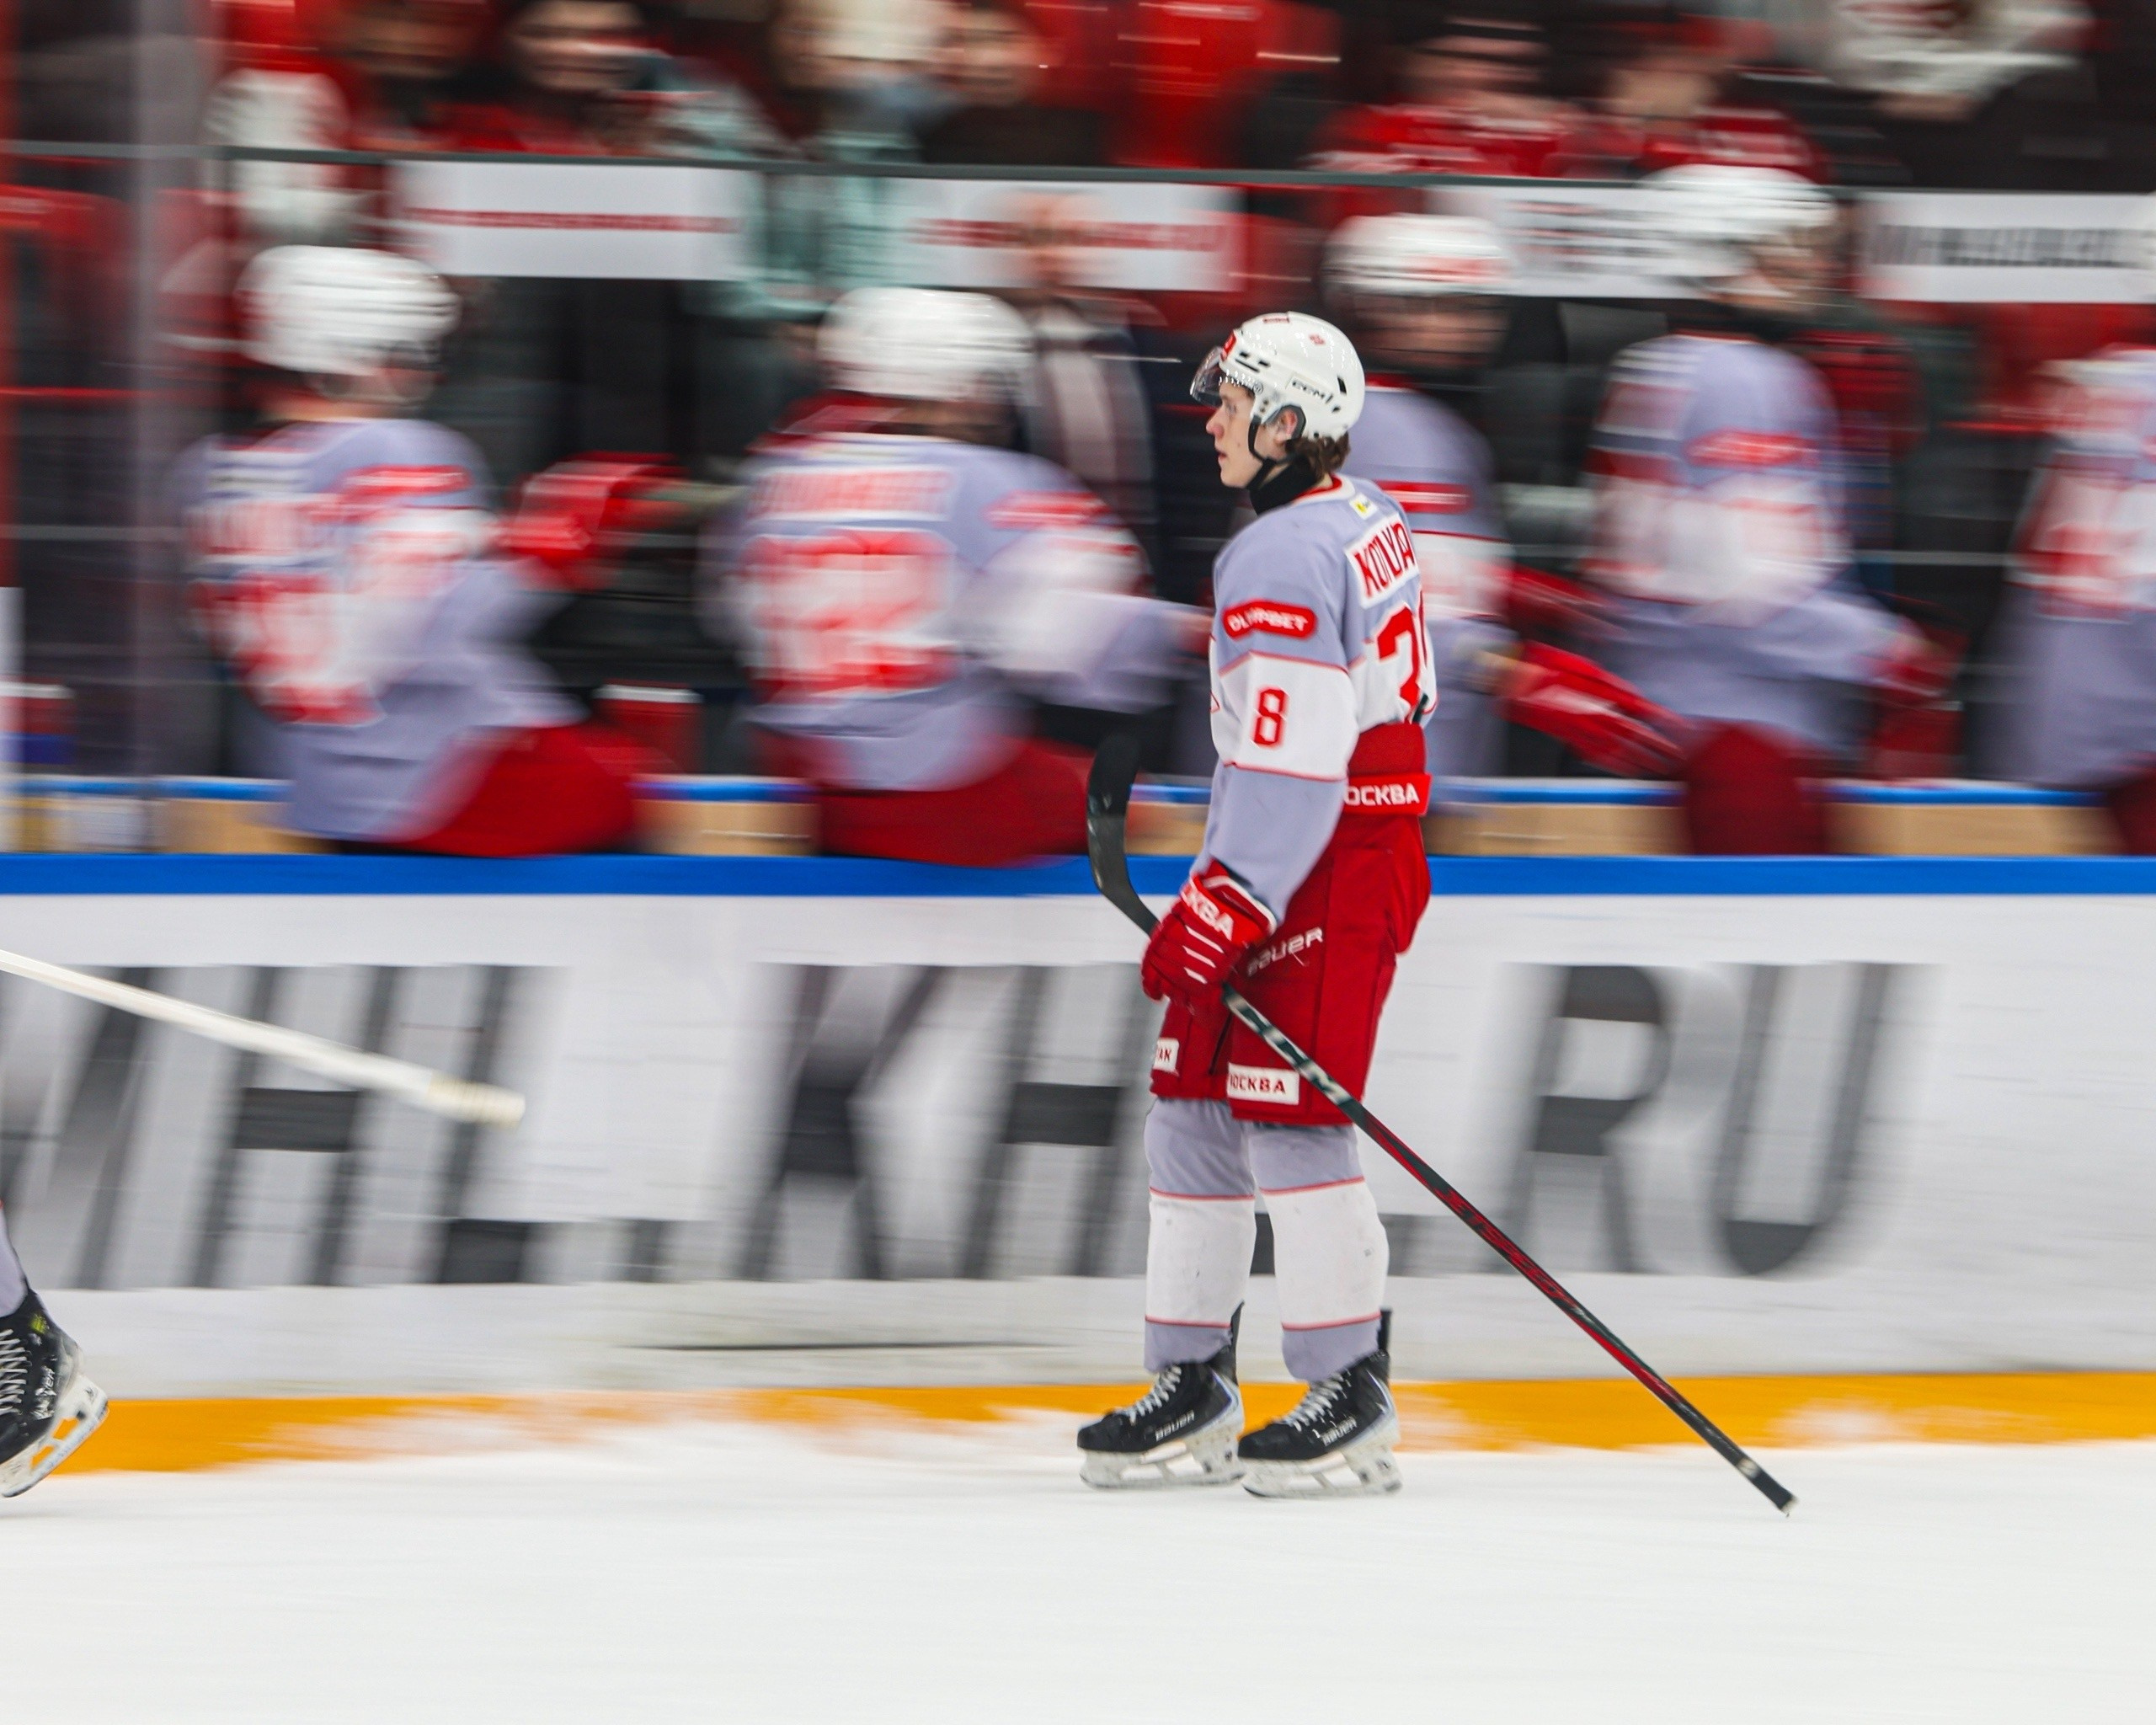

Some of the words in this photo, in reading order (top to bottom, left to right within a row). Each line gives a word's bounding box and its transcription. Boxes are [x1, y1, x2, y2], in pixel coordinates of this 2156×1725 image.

[1252, 686, 1287, 748] 8
[1345, 782, 1421, 806] ОСКВА
[1180, 886, 1235, 941] КВА
